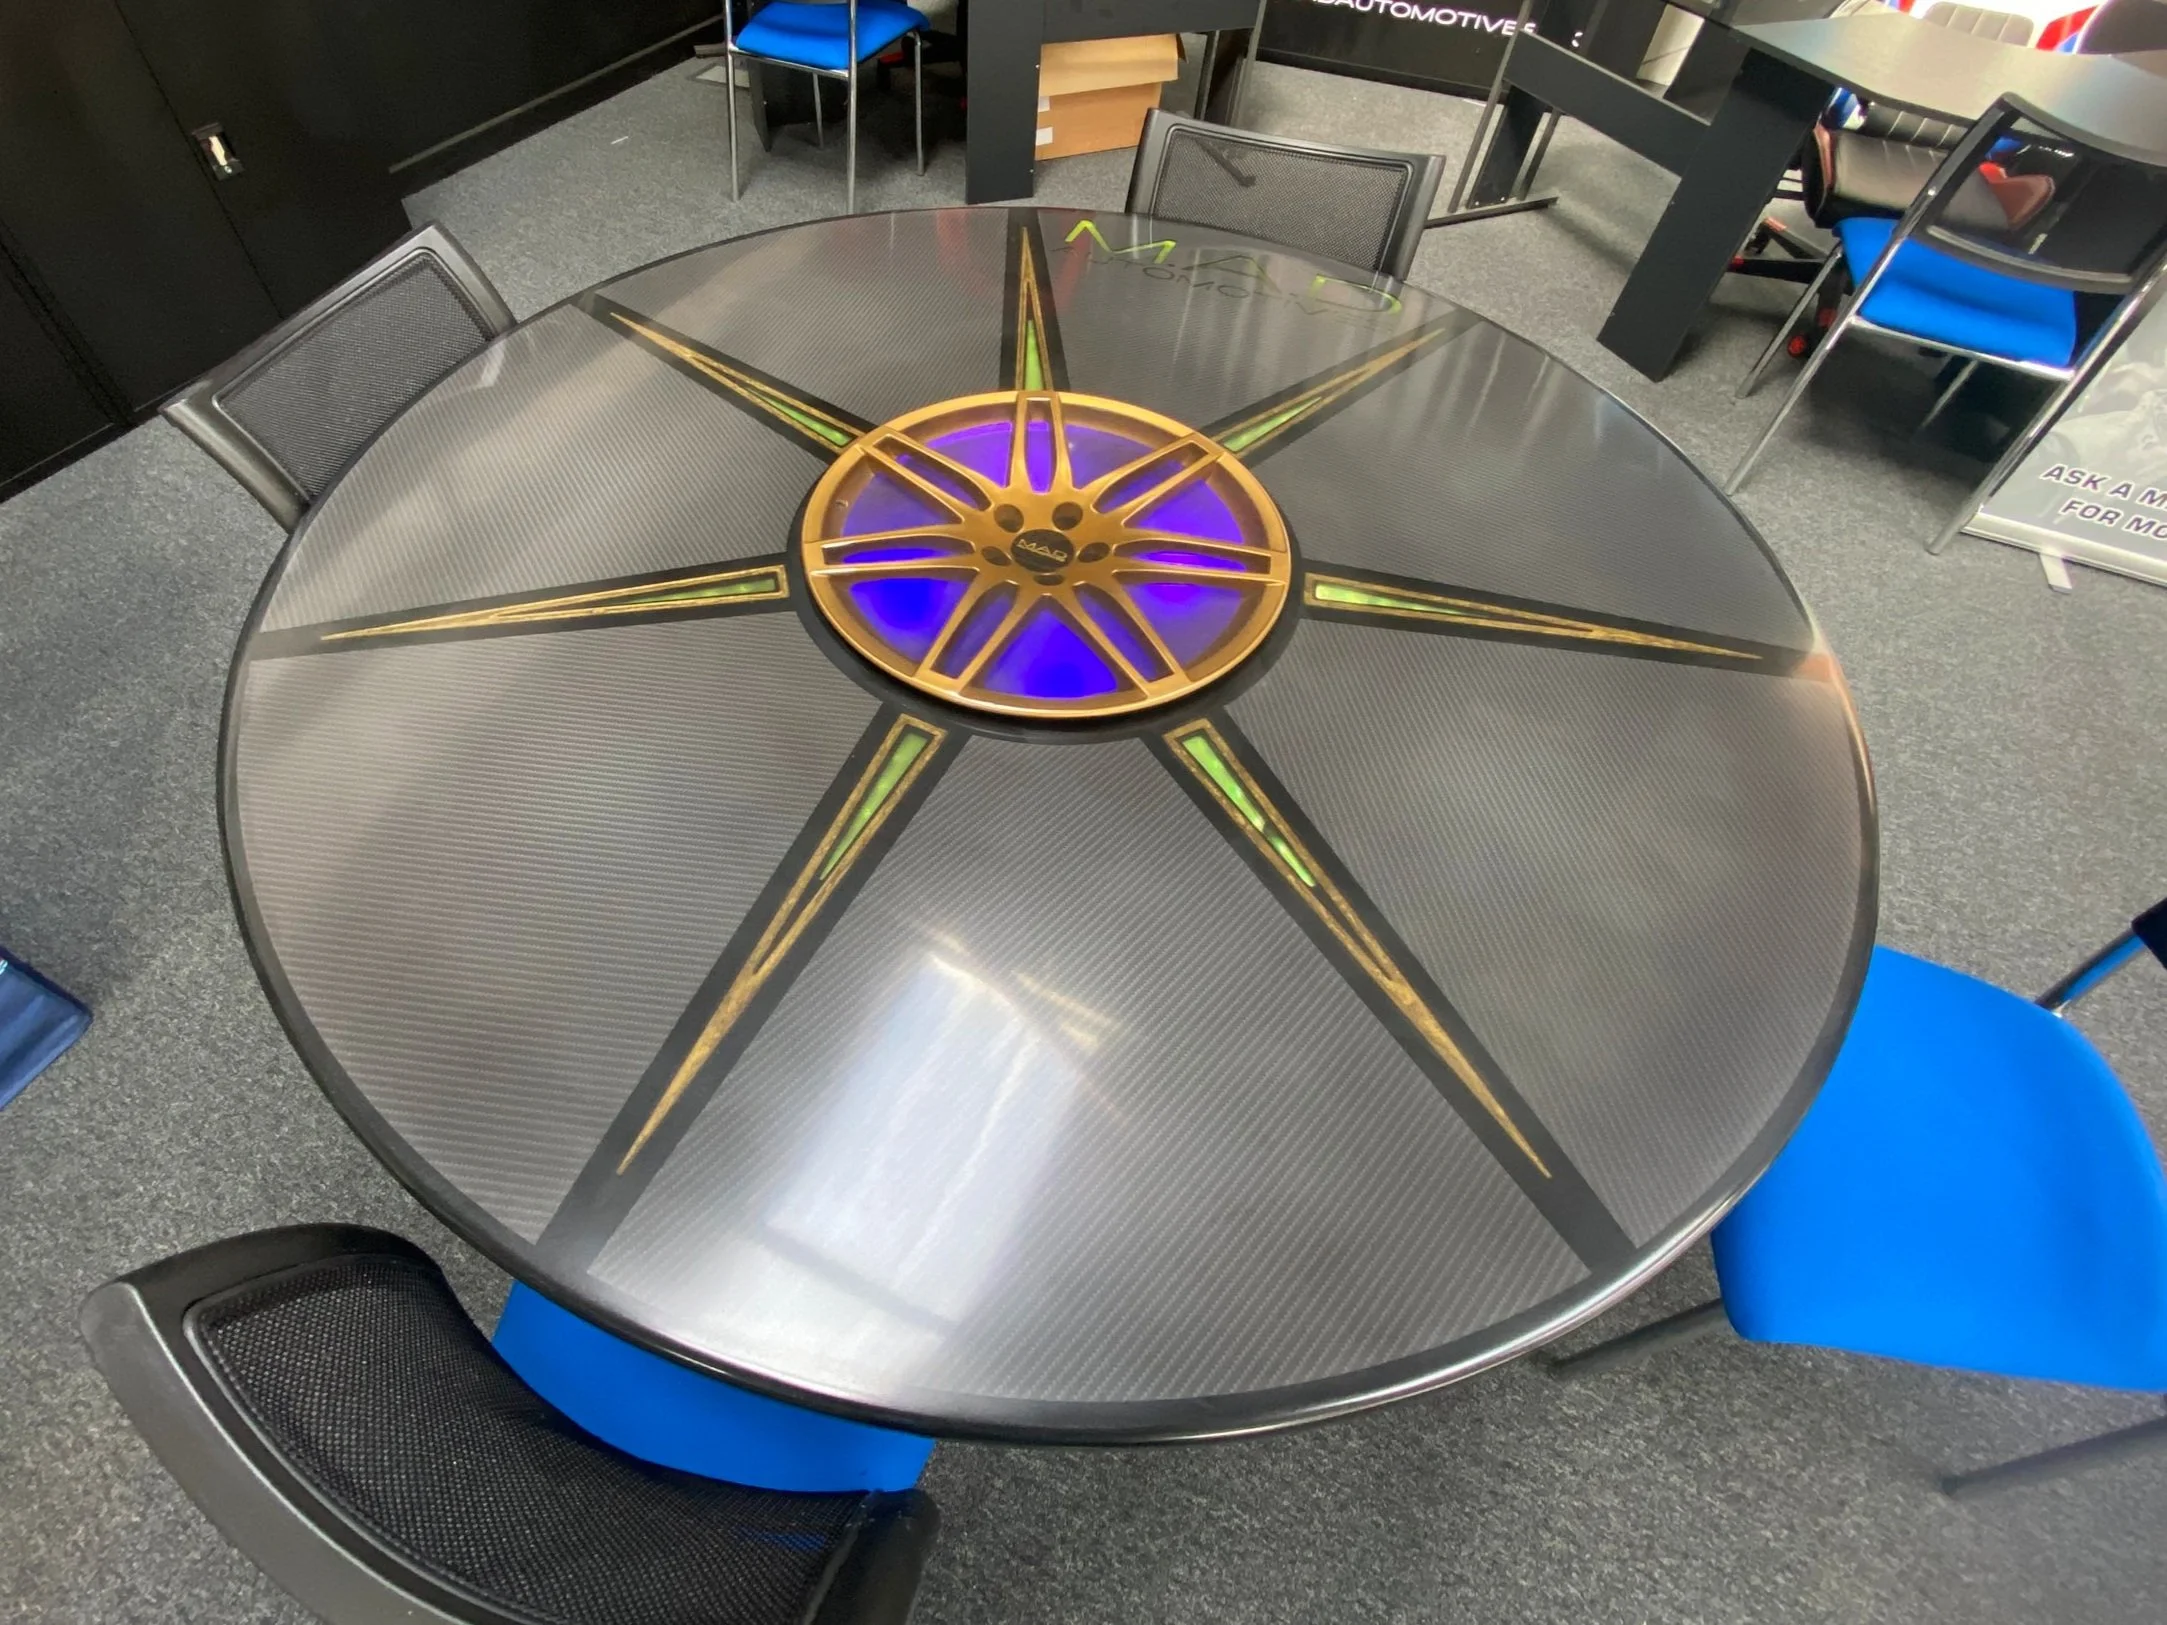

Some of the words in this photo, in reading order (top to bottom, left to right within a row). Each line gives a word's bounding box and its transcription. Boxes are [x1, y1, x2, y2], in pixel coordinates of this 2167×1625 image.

[2042, 465, 2107, 491] ASK
[2109, 482, 2133, 499] A
[2062, 500, 2121, 525] FOR
